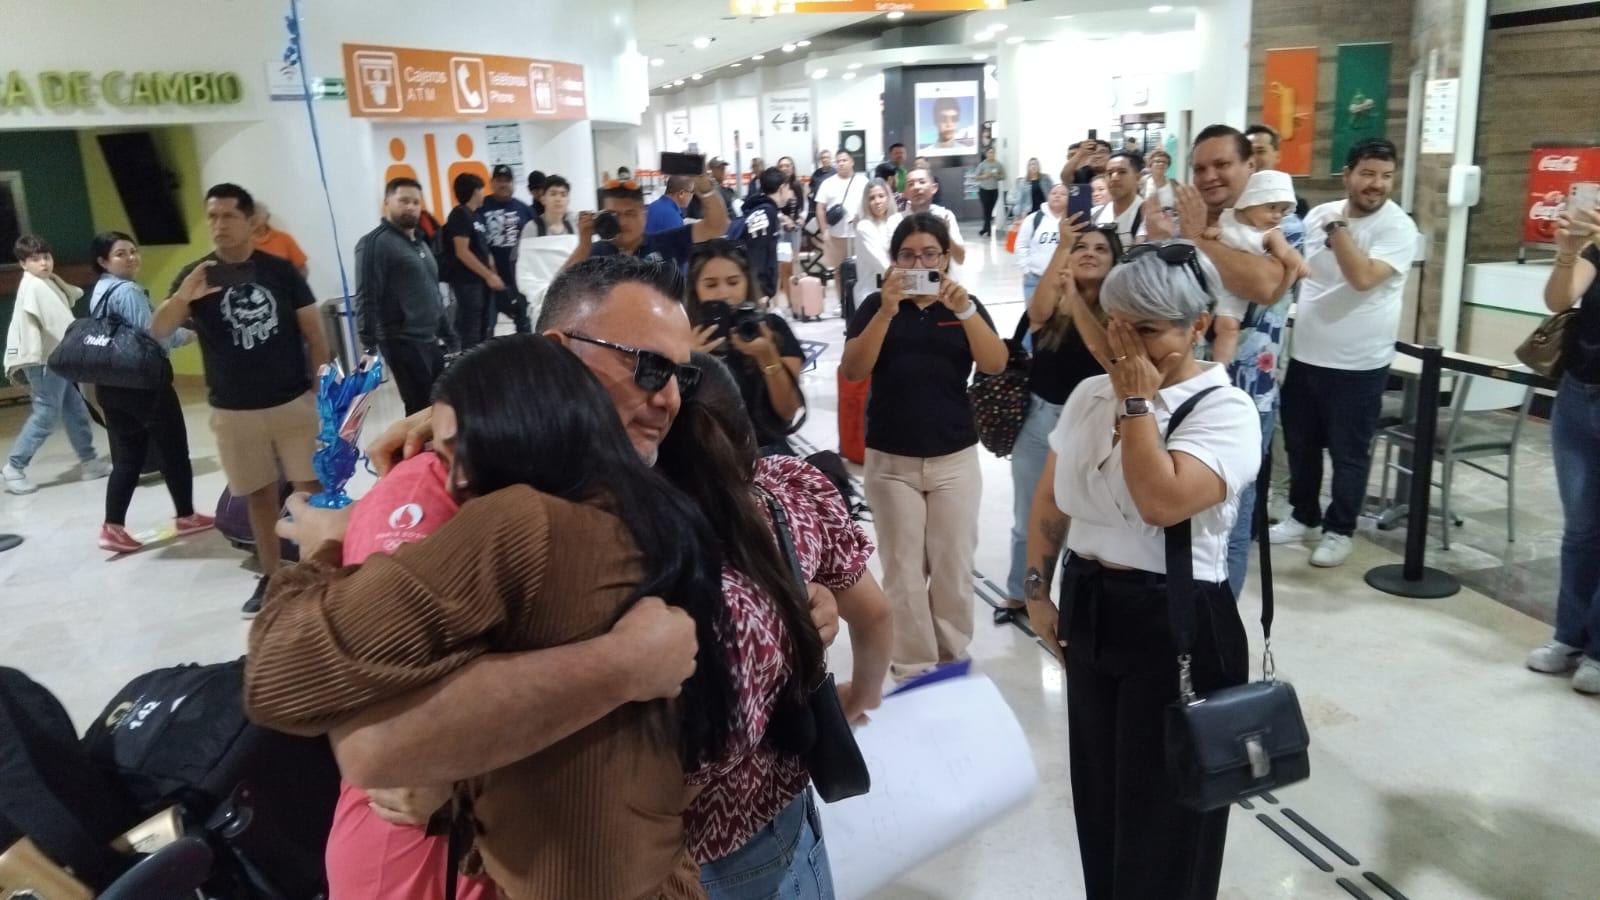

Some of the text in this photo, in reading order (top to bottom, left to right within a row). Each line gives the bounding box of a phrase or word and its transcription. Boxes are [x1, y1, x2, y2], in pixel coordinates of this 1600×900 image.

[404, 66, 448, 86] Cajeros
[0, 70, 243, 107] A DE CAMBIO
[406, 87, 437, 102] ATM
